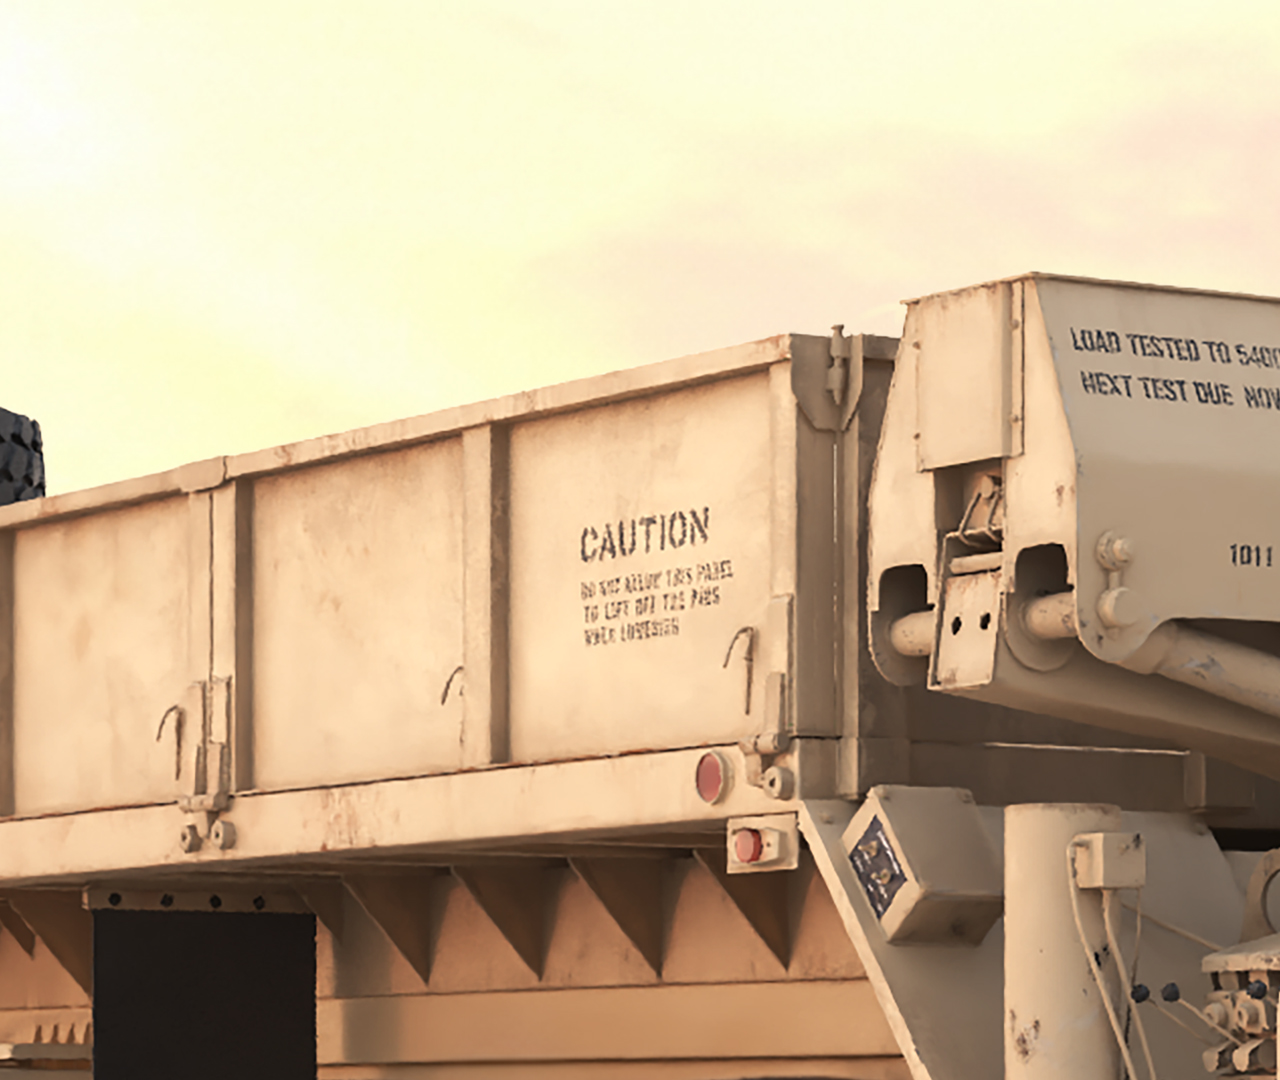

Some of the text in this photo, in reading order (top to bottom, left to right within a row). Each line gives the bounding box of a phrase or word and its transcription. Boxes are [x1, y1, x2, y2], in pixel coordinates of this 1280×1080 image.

[1070, 327, 1121, 354] LOAD
[1125, 333, 1201, 363] TESTED
[1202, 341, 1232, 364] TO
[1080, 371, 1133, 398] NEXT
[1138, 376, 1189, 403] TEST
[1194, 381, 1234, 407] DUE
[580, 507, 709, 563] CAUTION
